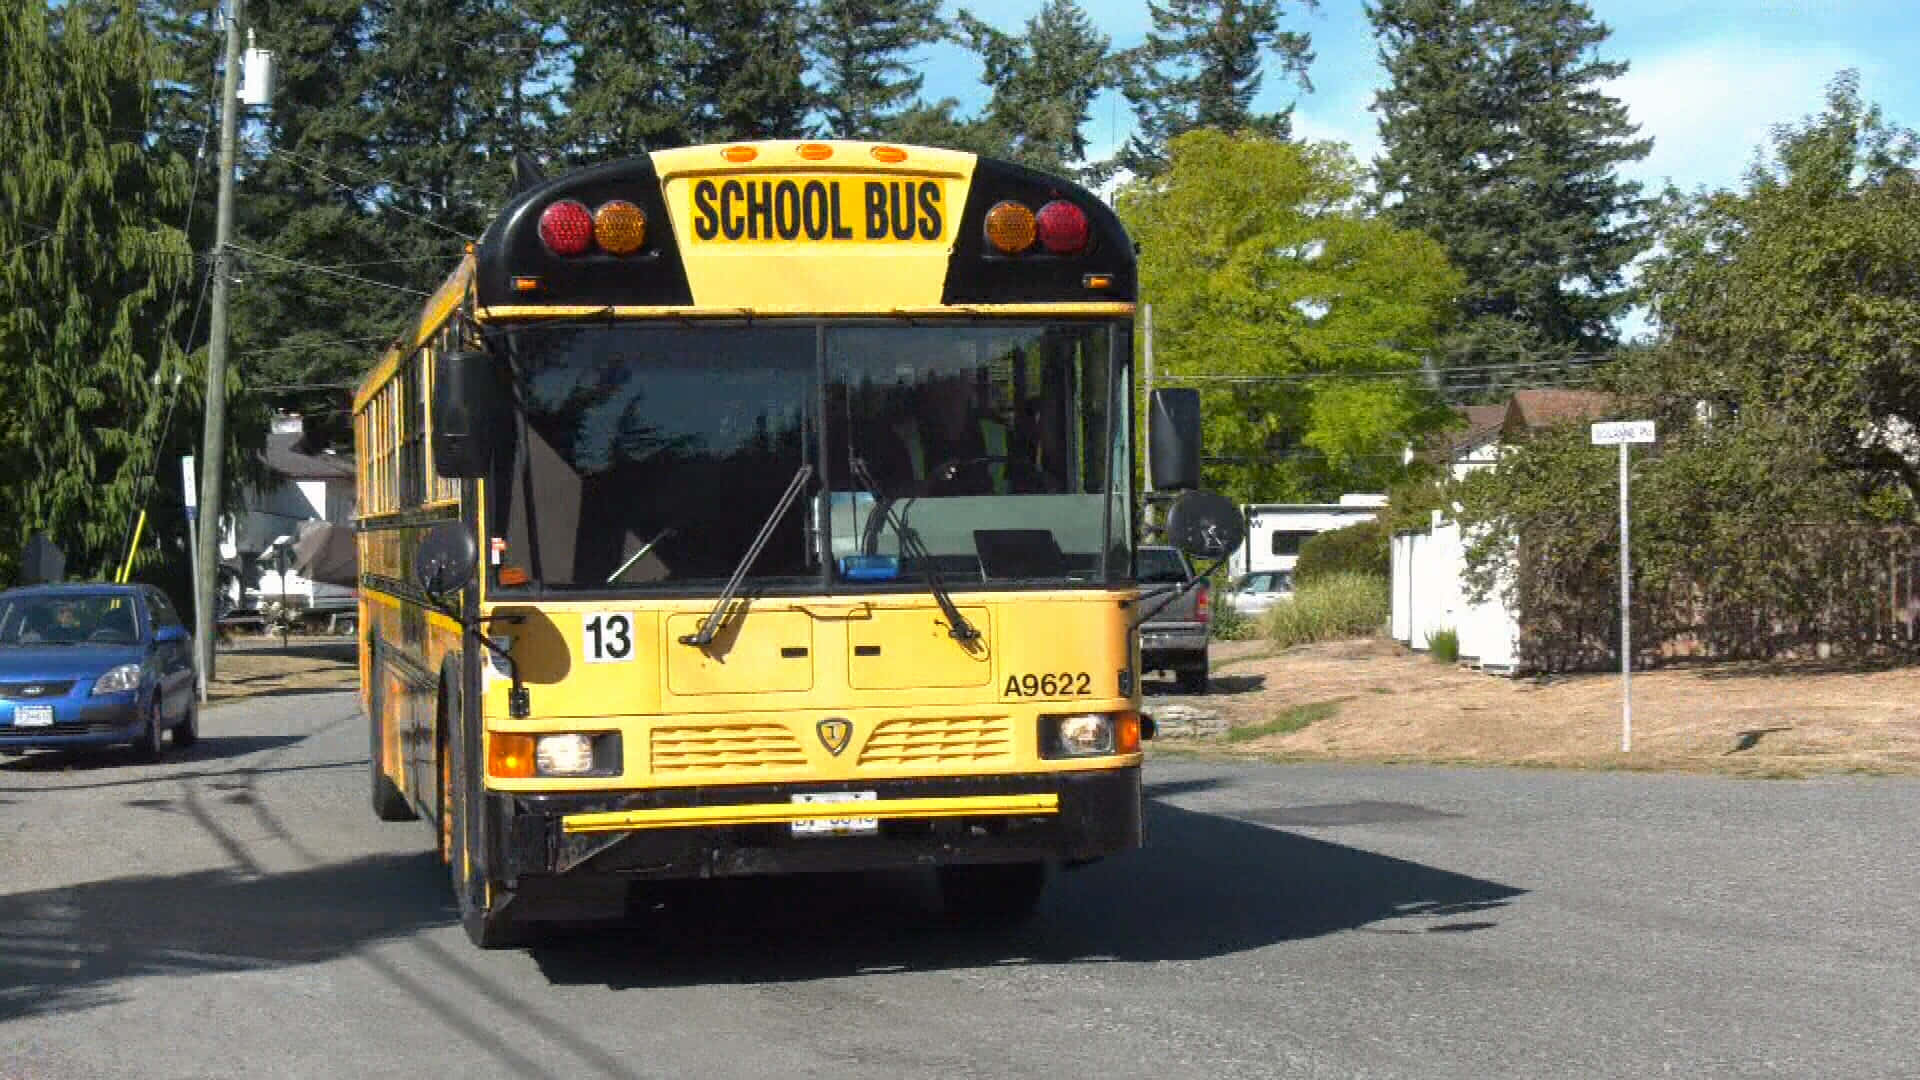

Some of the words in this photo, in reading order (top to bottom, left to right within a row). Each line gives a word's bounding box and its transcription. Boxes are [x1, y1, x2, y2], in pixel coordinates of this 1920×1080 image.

[694, 179, 853, 241] SCHOOL
[864, 180, 942, 241] BUS
[585, 613, 631, 658] 13
[1003, 672, 1092, 697] A9622
